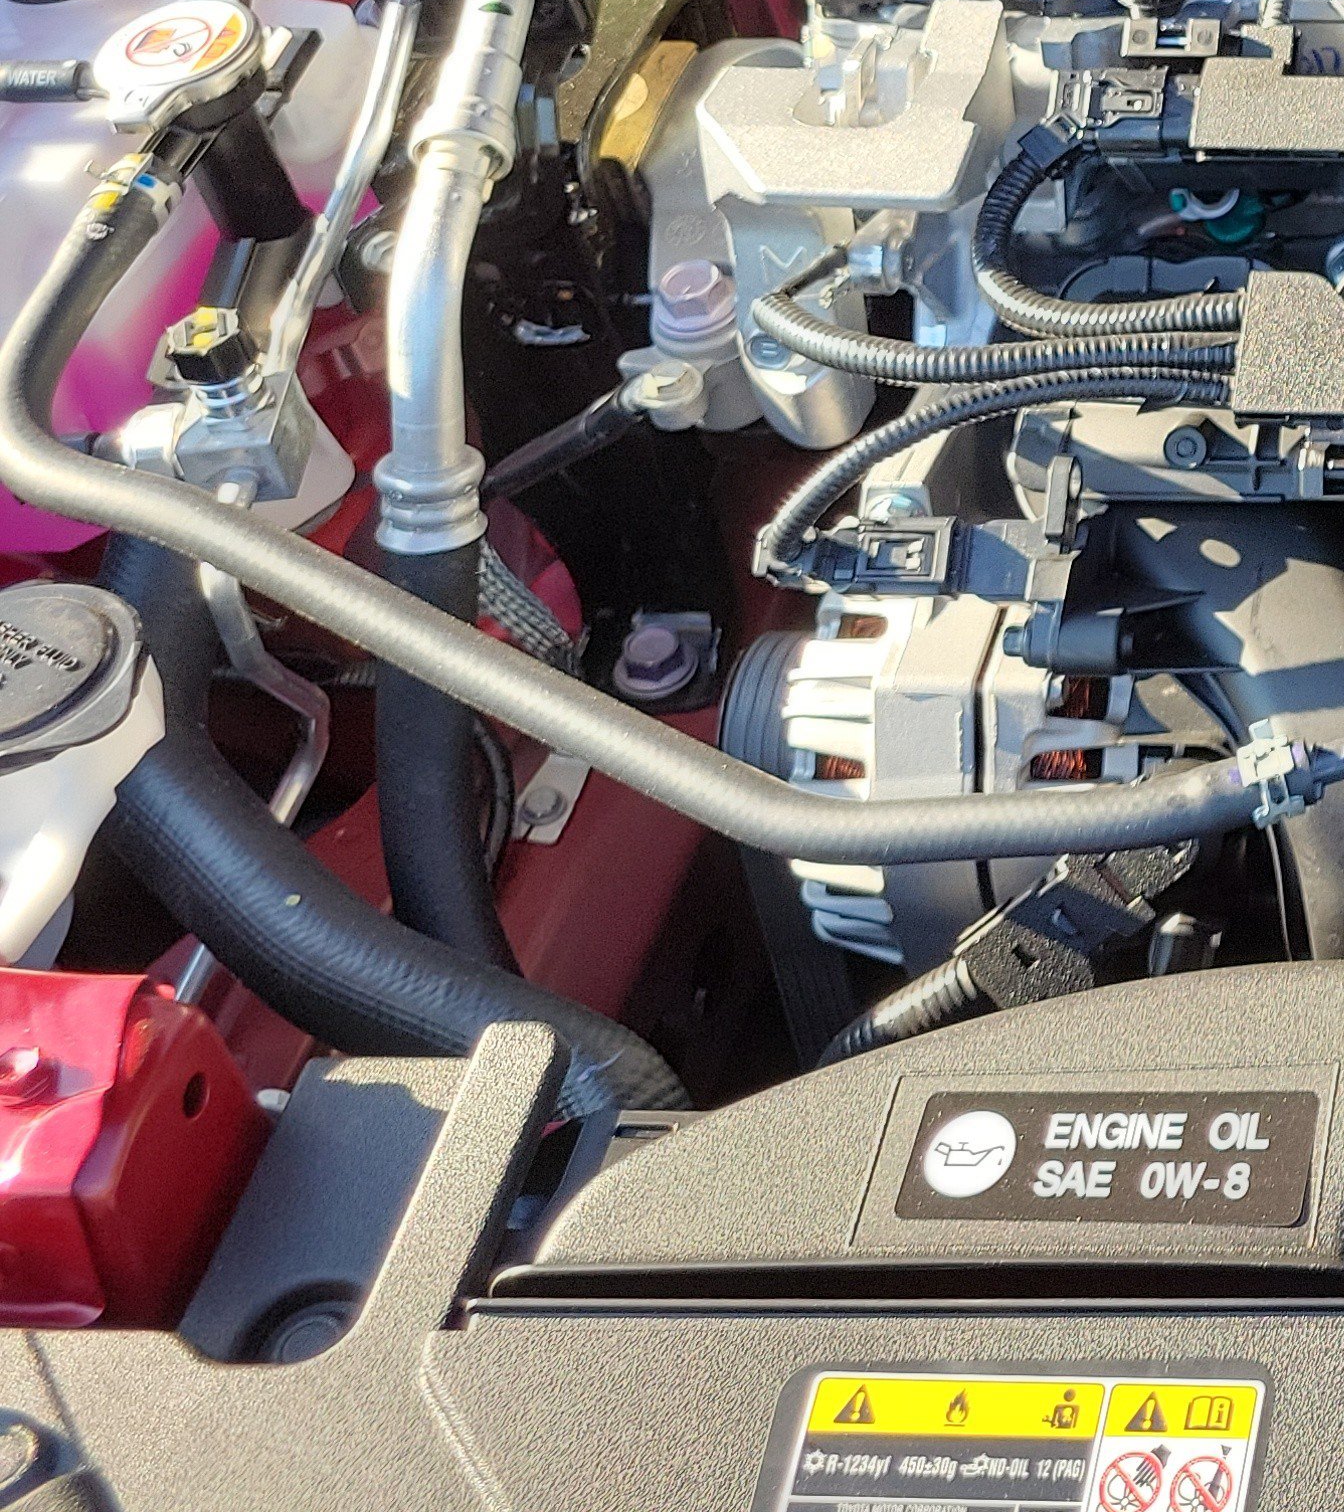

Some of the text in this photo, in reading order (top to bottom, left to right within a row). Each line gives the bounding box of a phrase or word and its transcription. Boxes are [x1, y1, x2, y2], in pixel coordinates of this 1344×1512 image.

[7, 69, 57, 87] WATER
[35, 643, 81, 672] FLUID
[1044, 1111, 1271, 1151] ENGINE OIL
[1032, 1159, 1252, 1201] SAE 0W-8
[825, 1453, 1086, 1484] R-1234yf 450±30g ND-OIL 12 (PAG)
